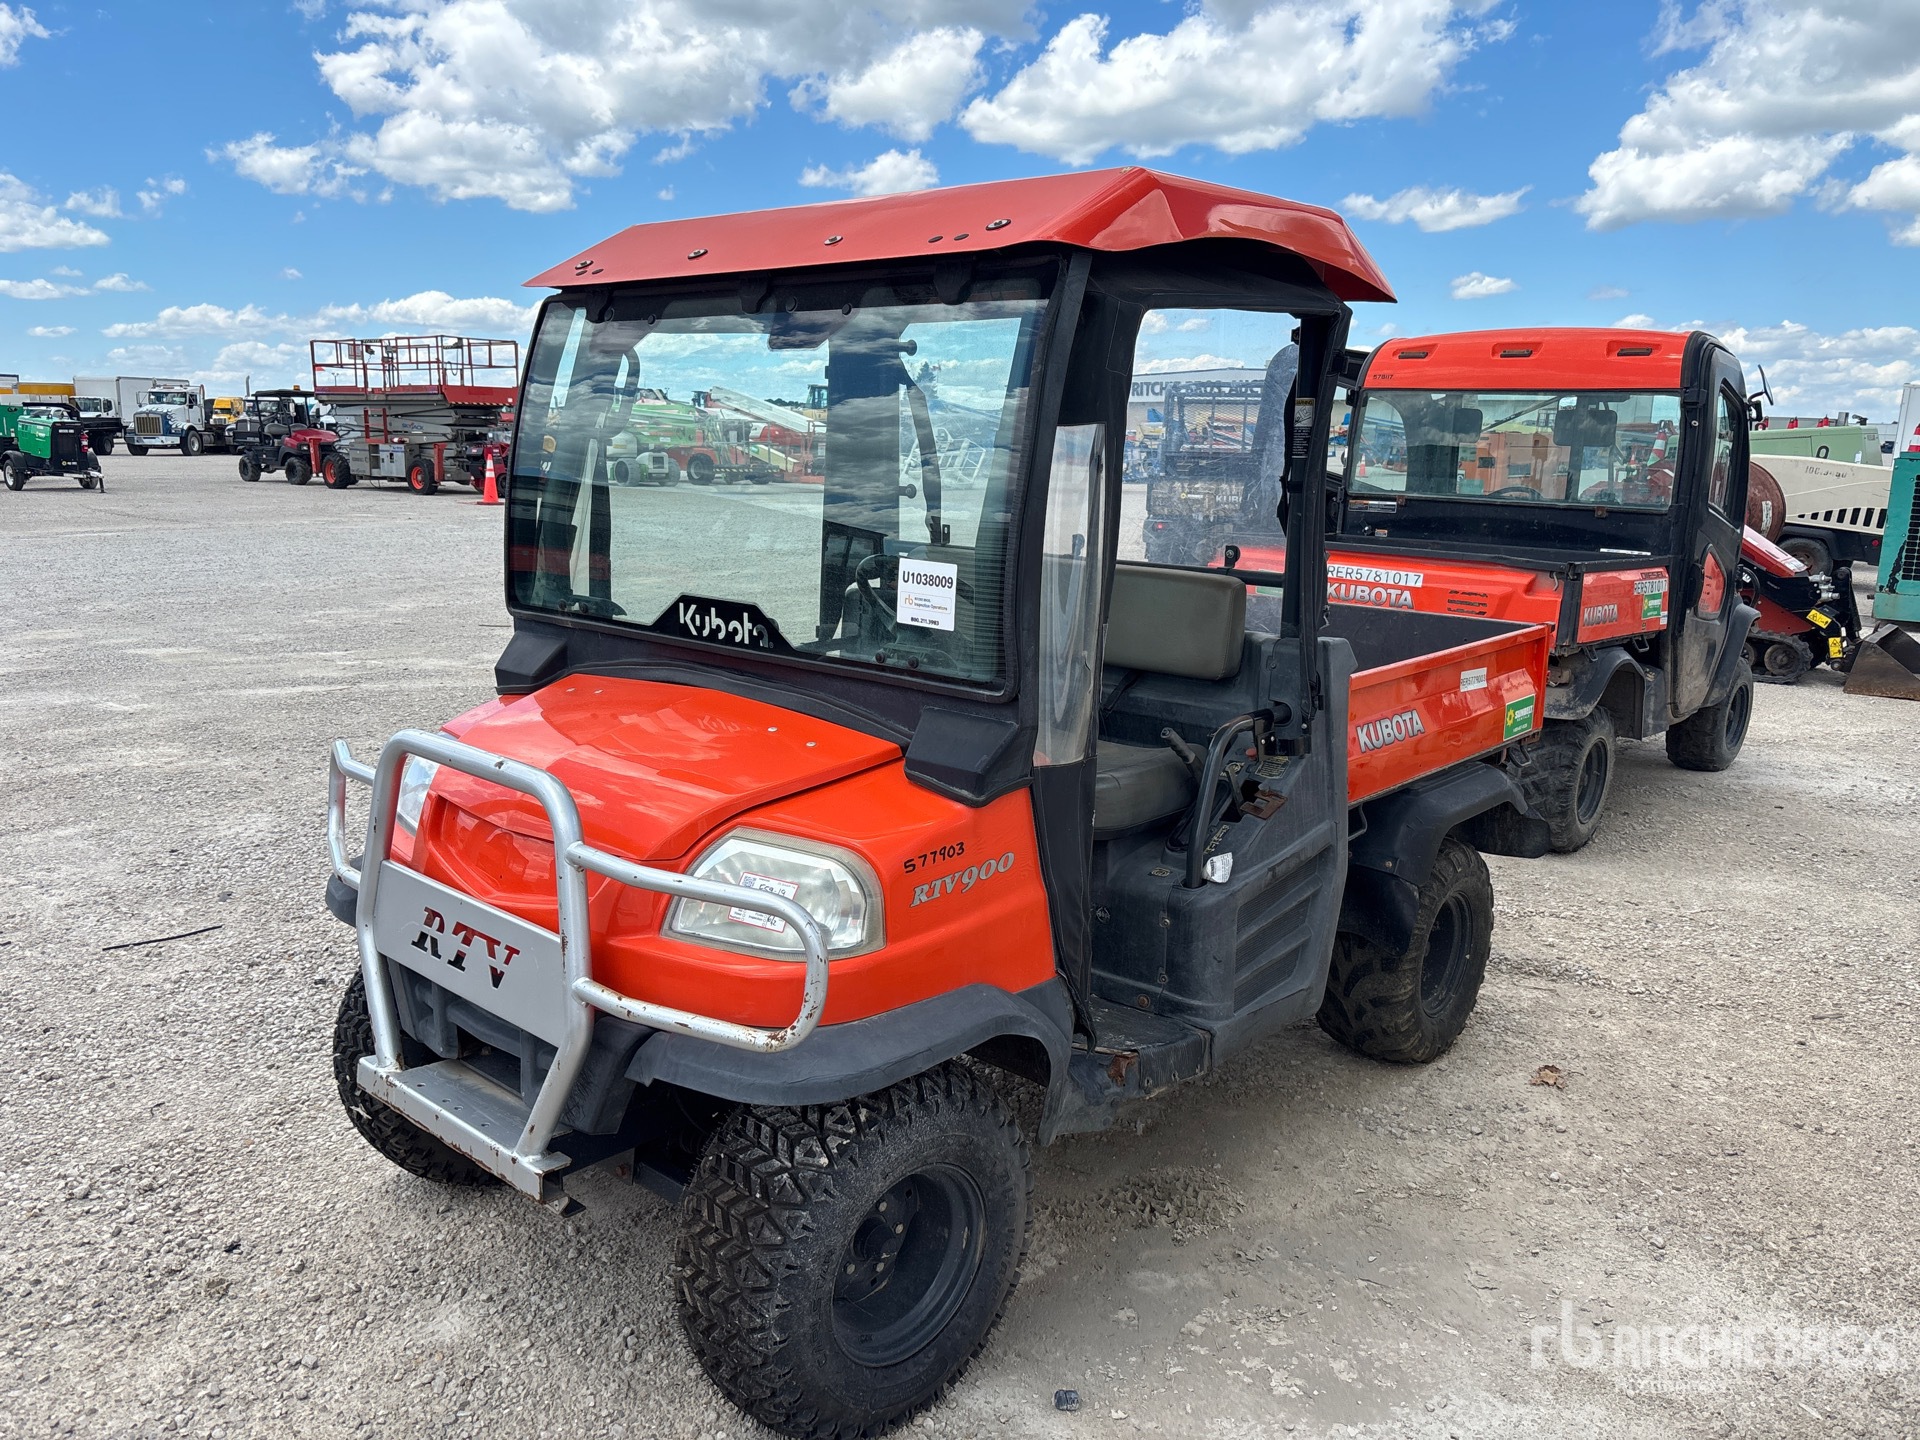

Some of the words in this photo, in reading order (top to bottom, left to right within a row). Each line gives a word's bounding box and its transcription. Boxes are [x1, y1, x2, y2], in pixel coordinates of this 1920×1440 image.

[902, 570, 953, 589] U1038009
[1327, 565, 1421, 586] RER5781017
[1327, 582, 1415, 610] KUBOTA
[678, 602, 769, 648] Kubota
[1583, 604, 1618, 627] KUBOTA
[1356, 708, 1425, 753] KUBOTA
[903, 841, 965, 874] 577903
[909, 851, 1015, 908] RTV900
[411, 906, 521, 990] RTV
